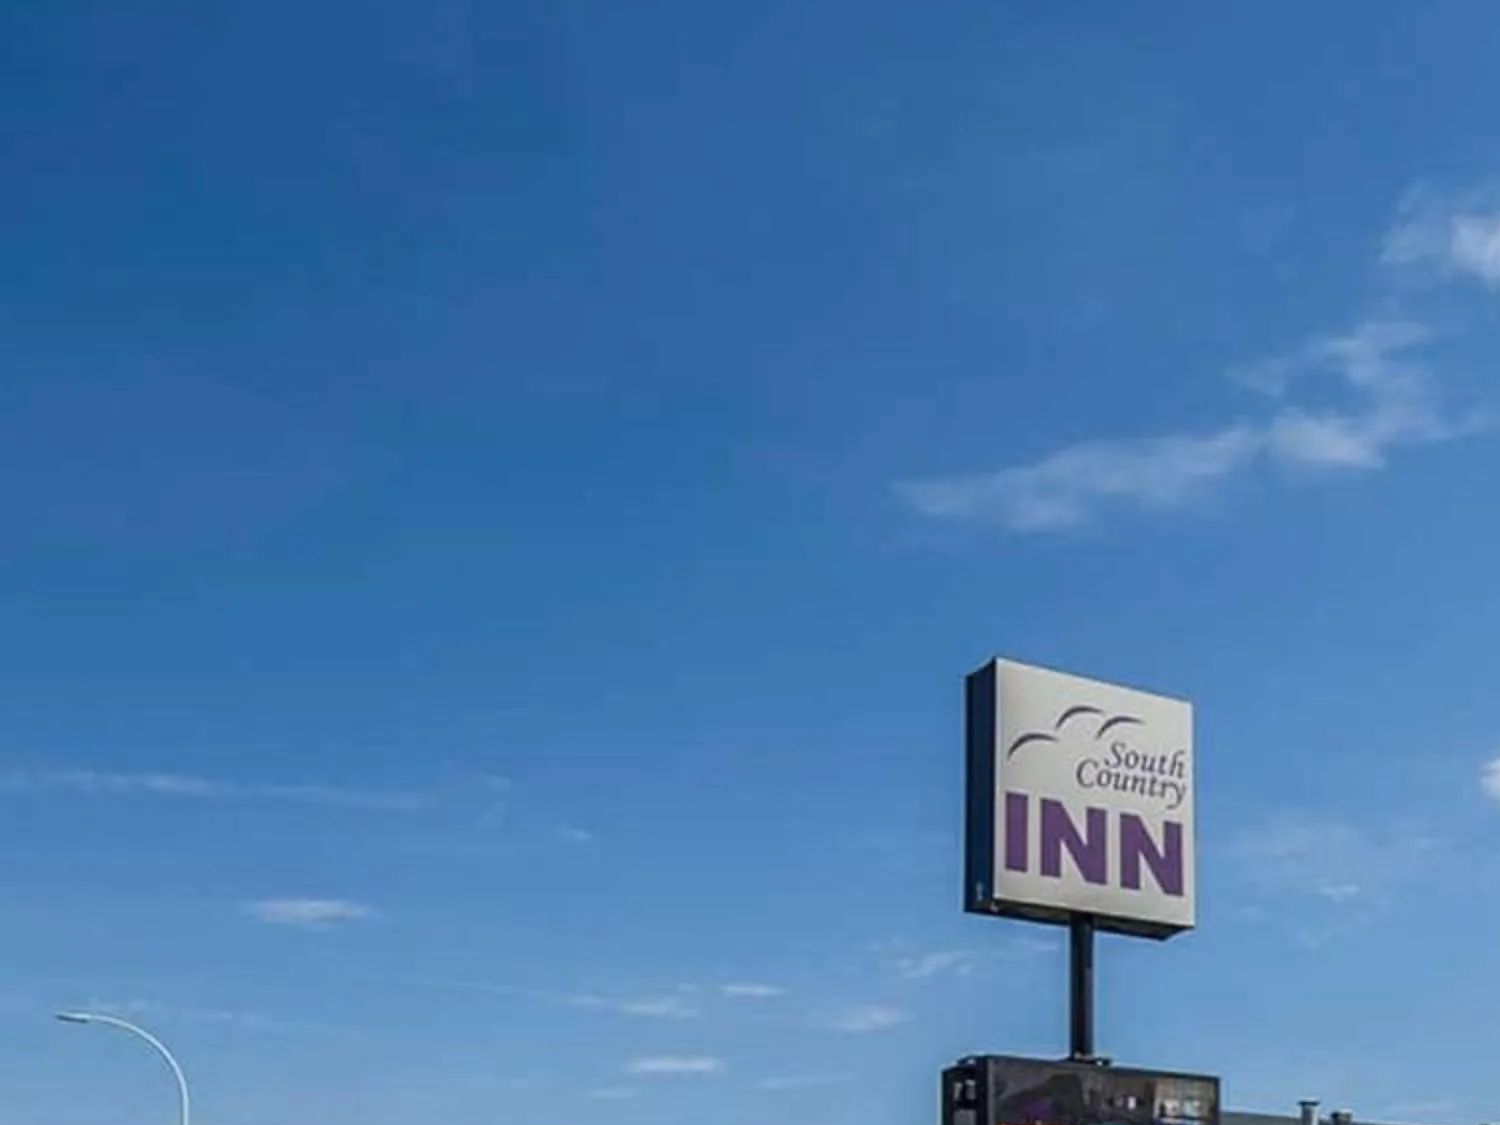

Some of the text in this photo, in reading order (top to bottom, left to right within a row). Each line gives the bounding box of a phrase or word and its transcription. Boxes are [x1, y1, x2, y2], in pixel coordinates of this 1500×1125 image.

[1075, 758, 1187, 810] Country
[1103, 742, 1185, 780] South
[1005, 791, 1185, 898] INN
